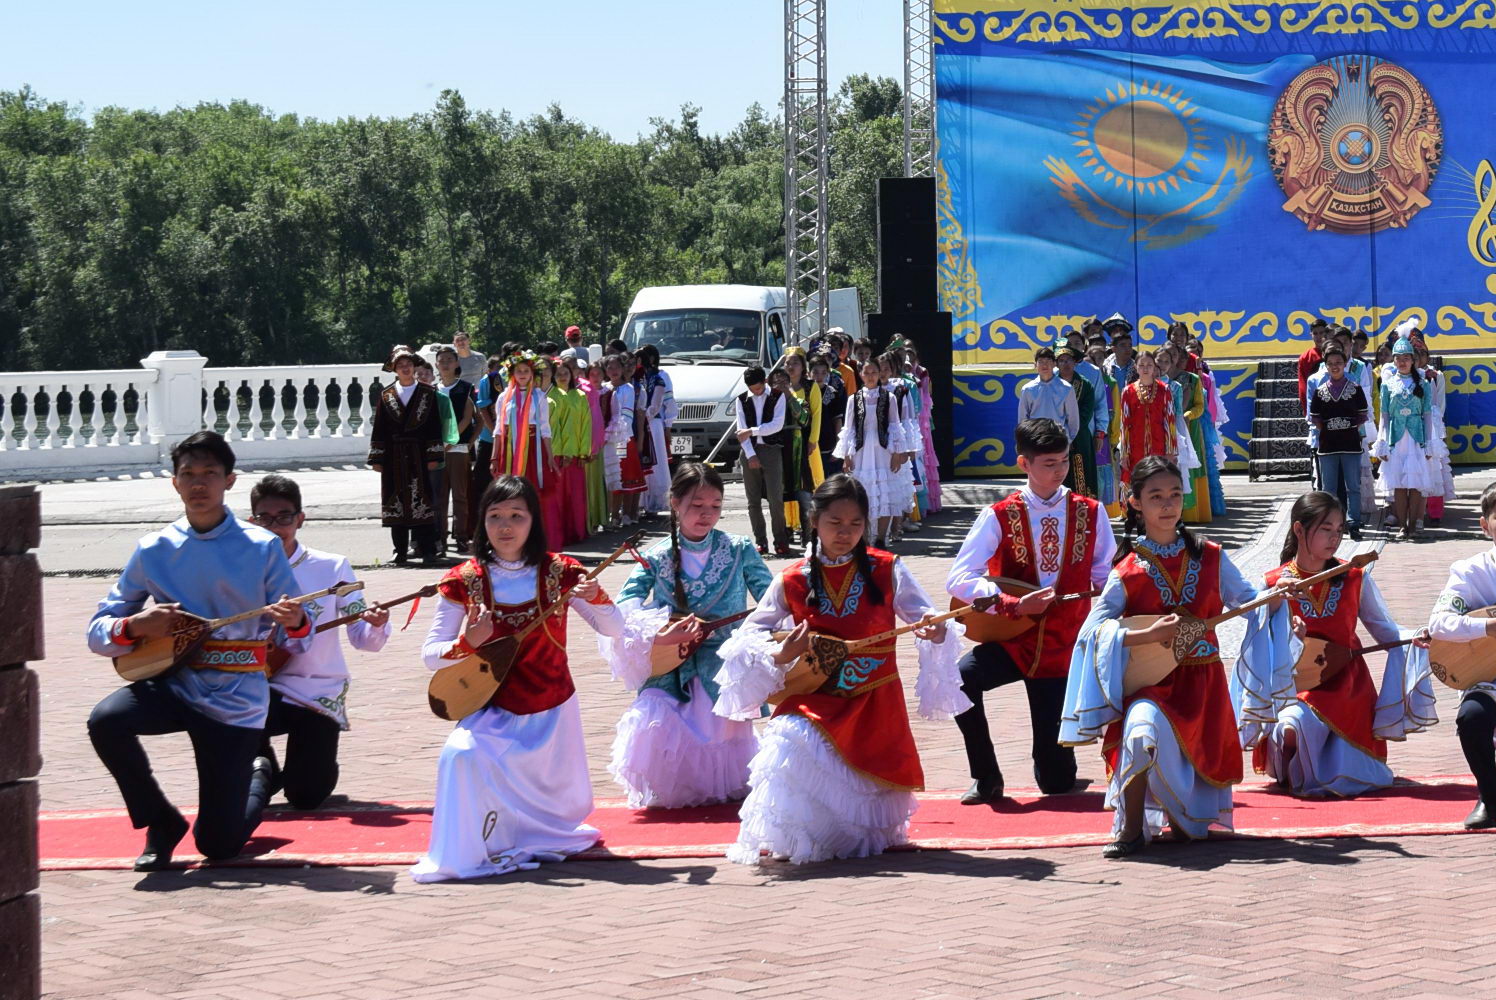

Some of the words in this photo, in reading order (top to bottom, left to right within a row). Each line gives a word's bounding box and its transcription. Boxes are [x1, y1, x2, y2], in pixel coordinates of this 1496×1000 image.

[1331, 199, 1383, 213] ҚАЗАҚСТАН
[676, 437, 691, 445] 679
[674, 445, 685, 453] PP
